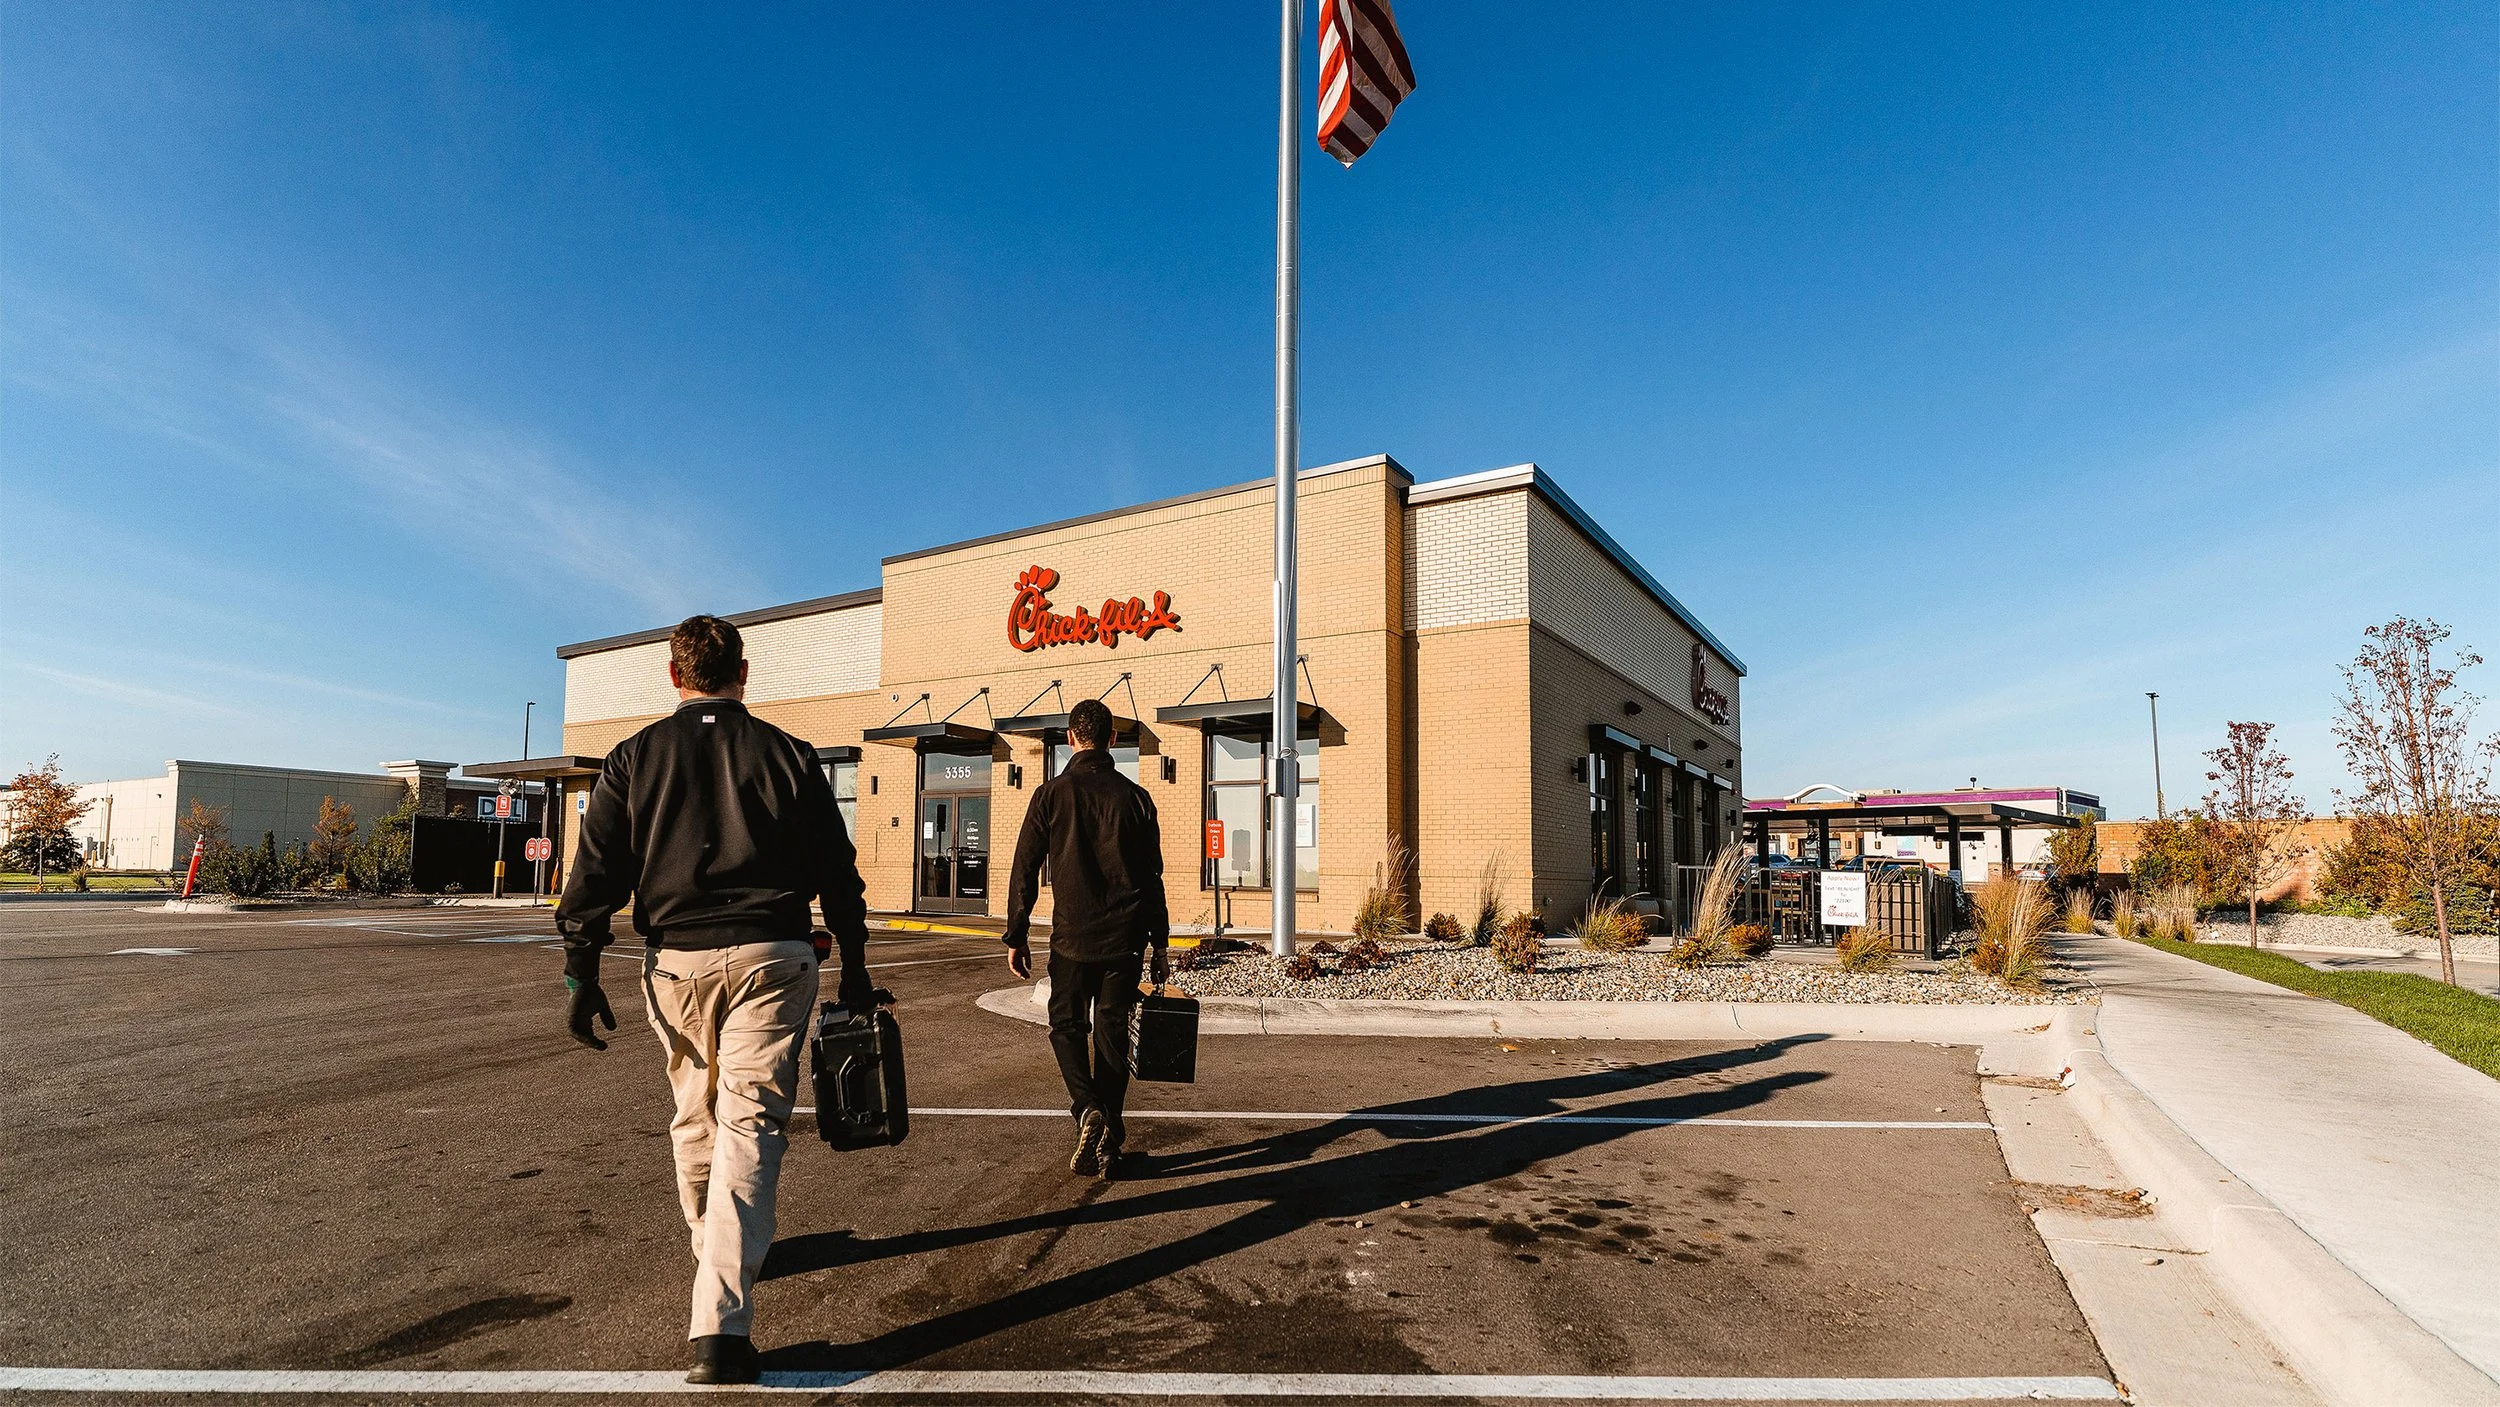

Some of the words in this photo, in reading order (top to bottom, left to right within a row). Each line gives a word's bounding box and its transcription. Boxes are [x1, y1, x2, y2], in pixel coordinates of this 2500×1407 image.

[1007, 565, 1180, 650] Chick-fil-A
[945, 766, 972, 779] 3355
[480, 798, 523, 817] DL
